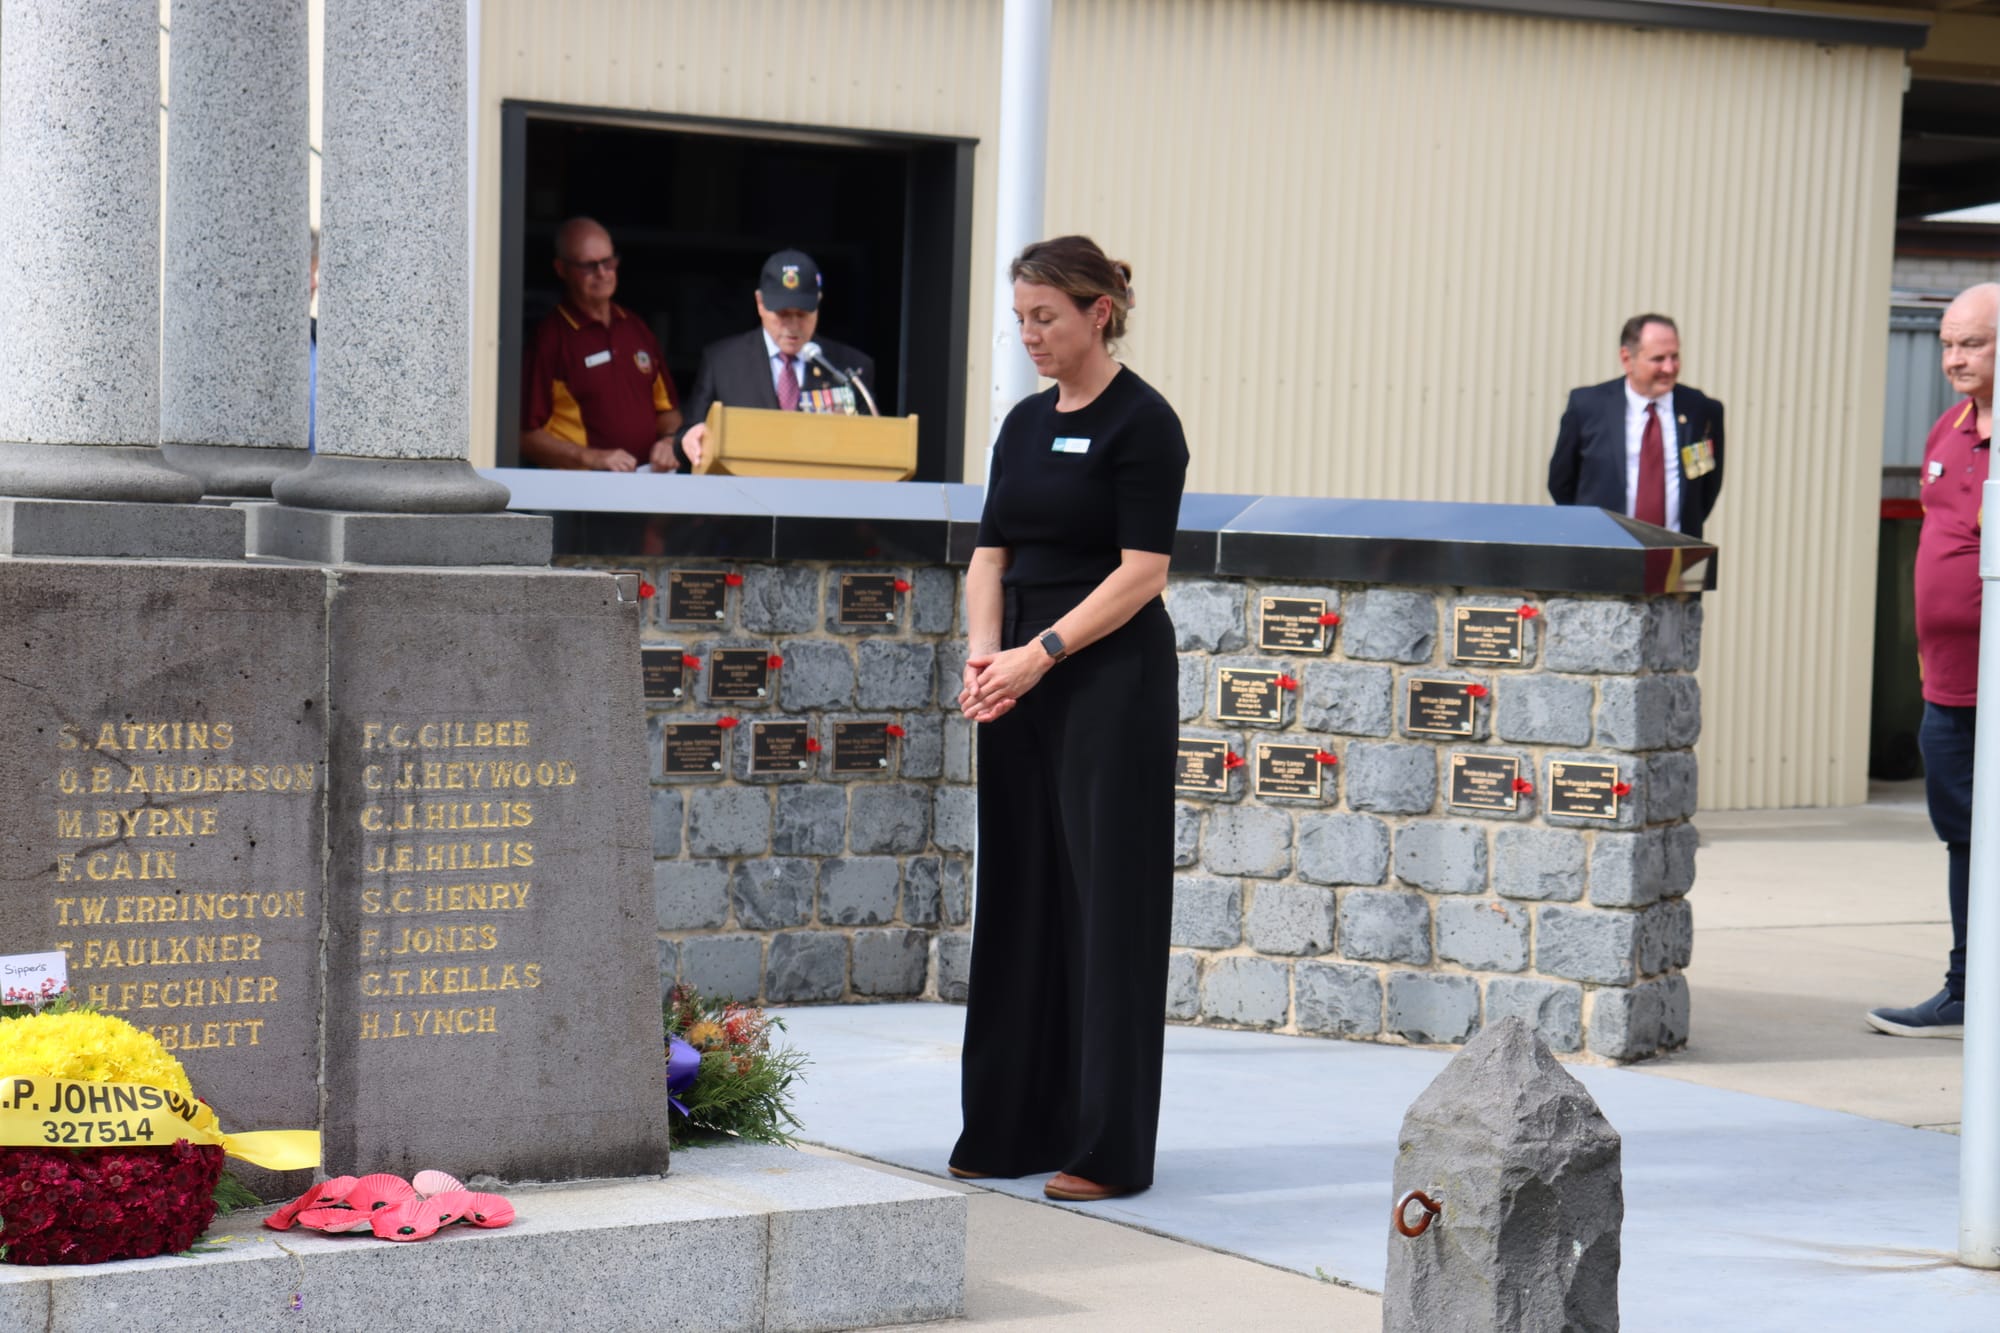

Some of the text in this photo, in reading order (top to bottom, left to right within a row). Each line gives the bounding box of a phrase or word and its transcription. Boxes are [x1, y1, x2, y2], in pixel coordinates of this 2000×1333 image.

[57, 807, 219, 838] M.BYRNE
[147, 1020, 264, 1050] BLETT
[42, 1117, 154, 1144] 327514
